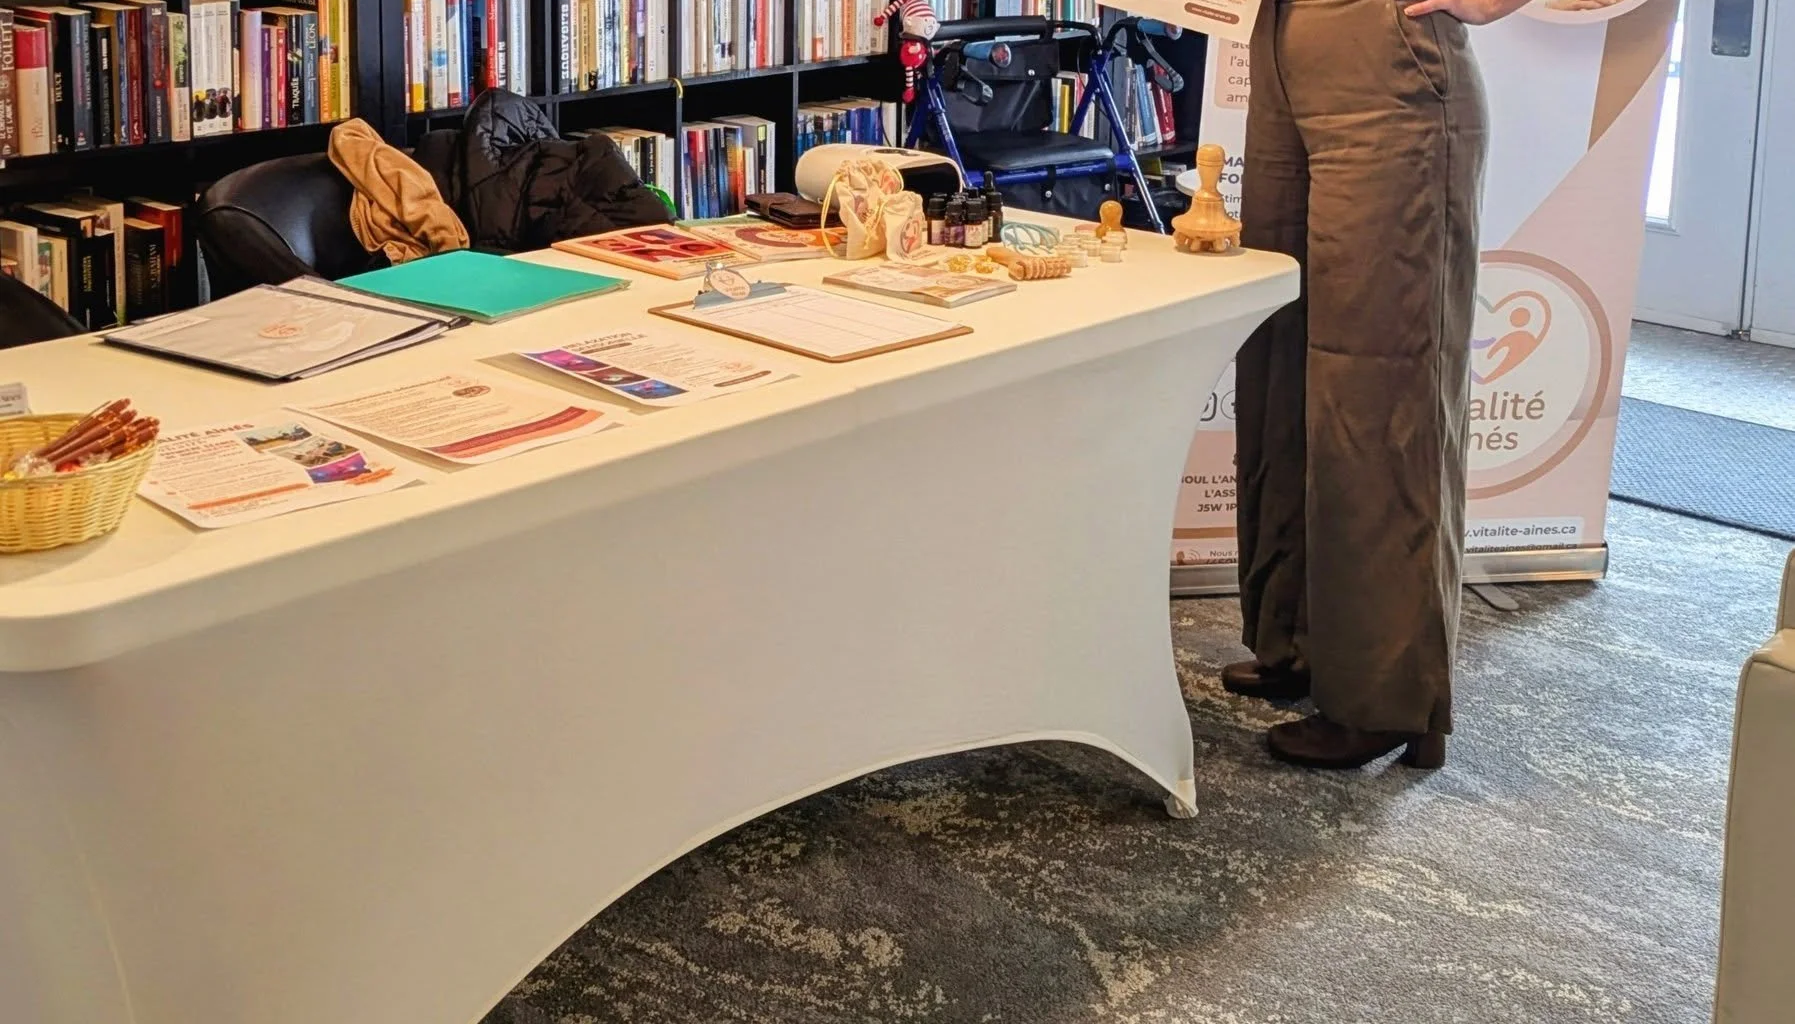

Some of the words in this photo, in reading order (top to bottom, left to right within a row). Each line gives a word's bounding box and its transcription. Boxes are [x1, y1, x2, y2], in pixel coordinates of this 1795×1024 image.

[2, 18, 14, 70] FOLLETT
[308, 23, 316, 49] LEON
[290, 77, 299, 108] TRAQUÉE
[1197, 503, 1223, 512] J5W
